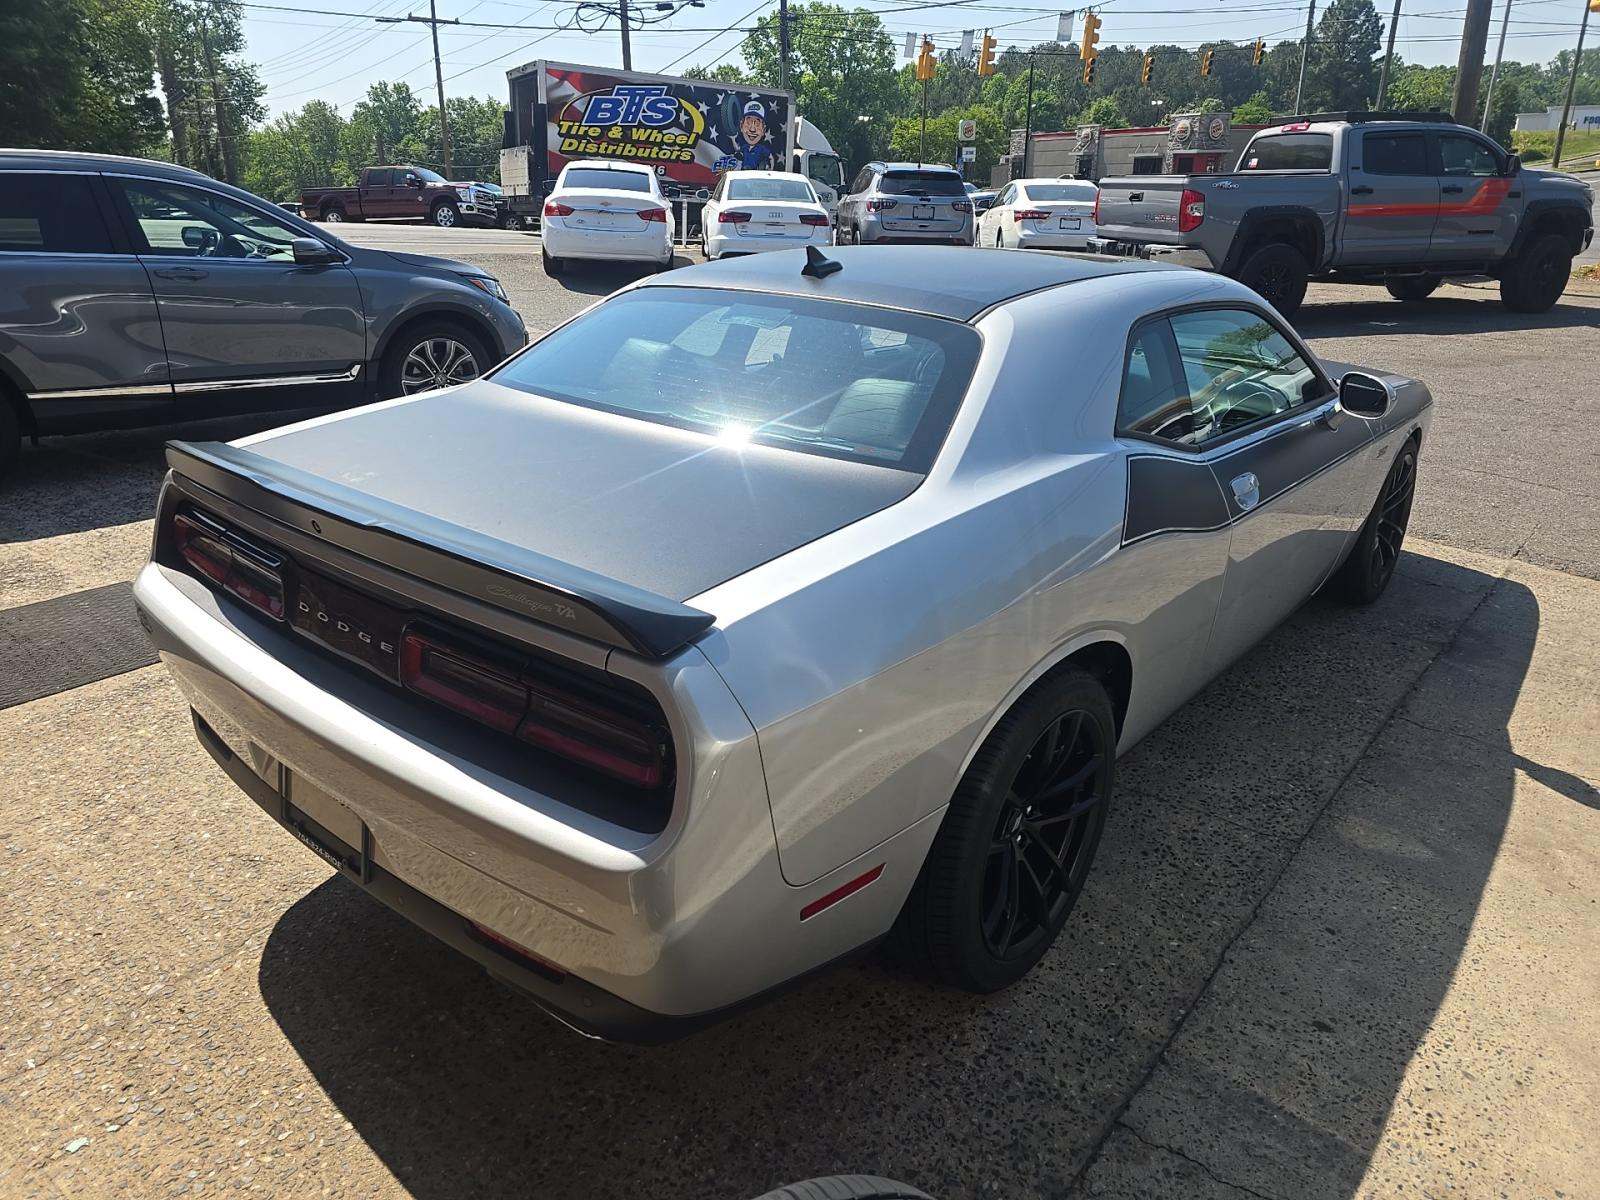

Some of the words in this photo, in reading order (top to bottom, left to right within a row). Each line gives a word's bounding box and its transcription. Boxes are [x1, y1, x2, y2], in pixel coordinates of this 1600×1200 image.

[582, 85, 678, 125] BTS
[560, 121, 602, 137] Tire
[607, 125, 624, 139] &
[631, 128, 697, 146] Wheel
[561, 138, 692, 161] Distributors
[299, 600, 394, 653] DODGE
